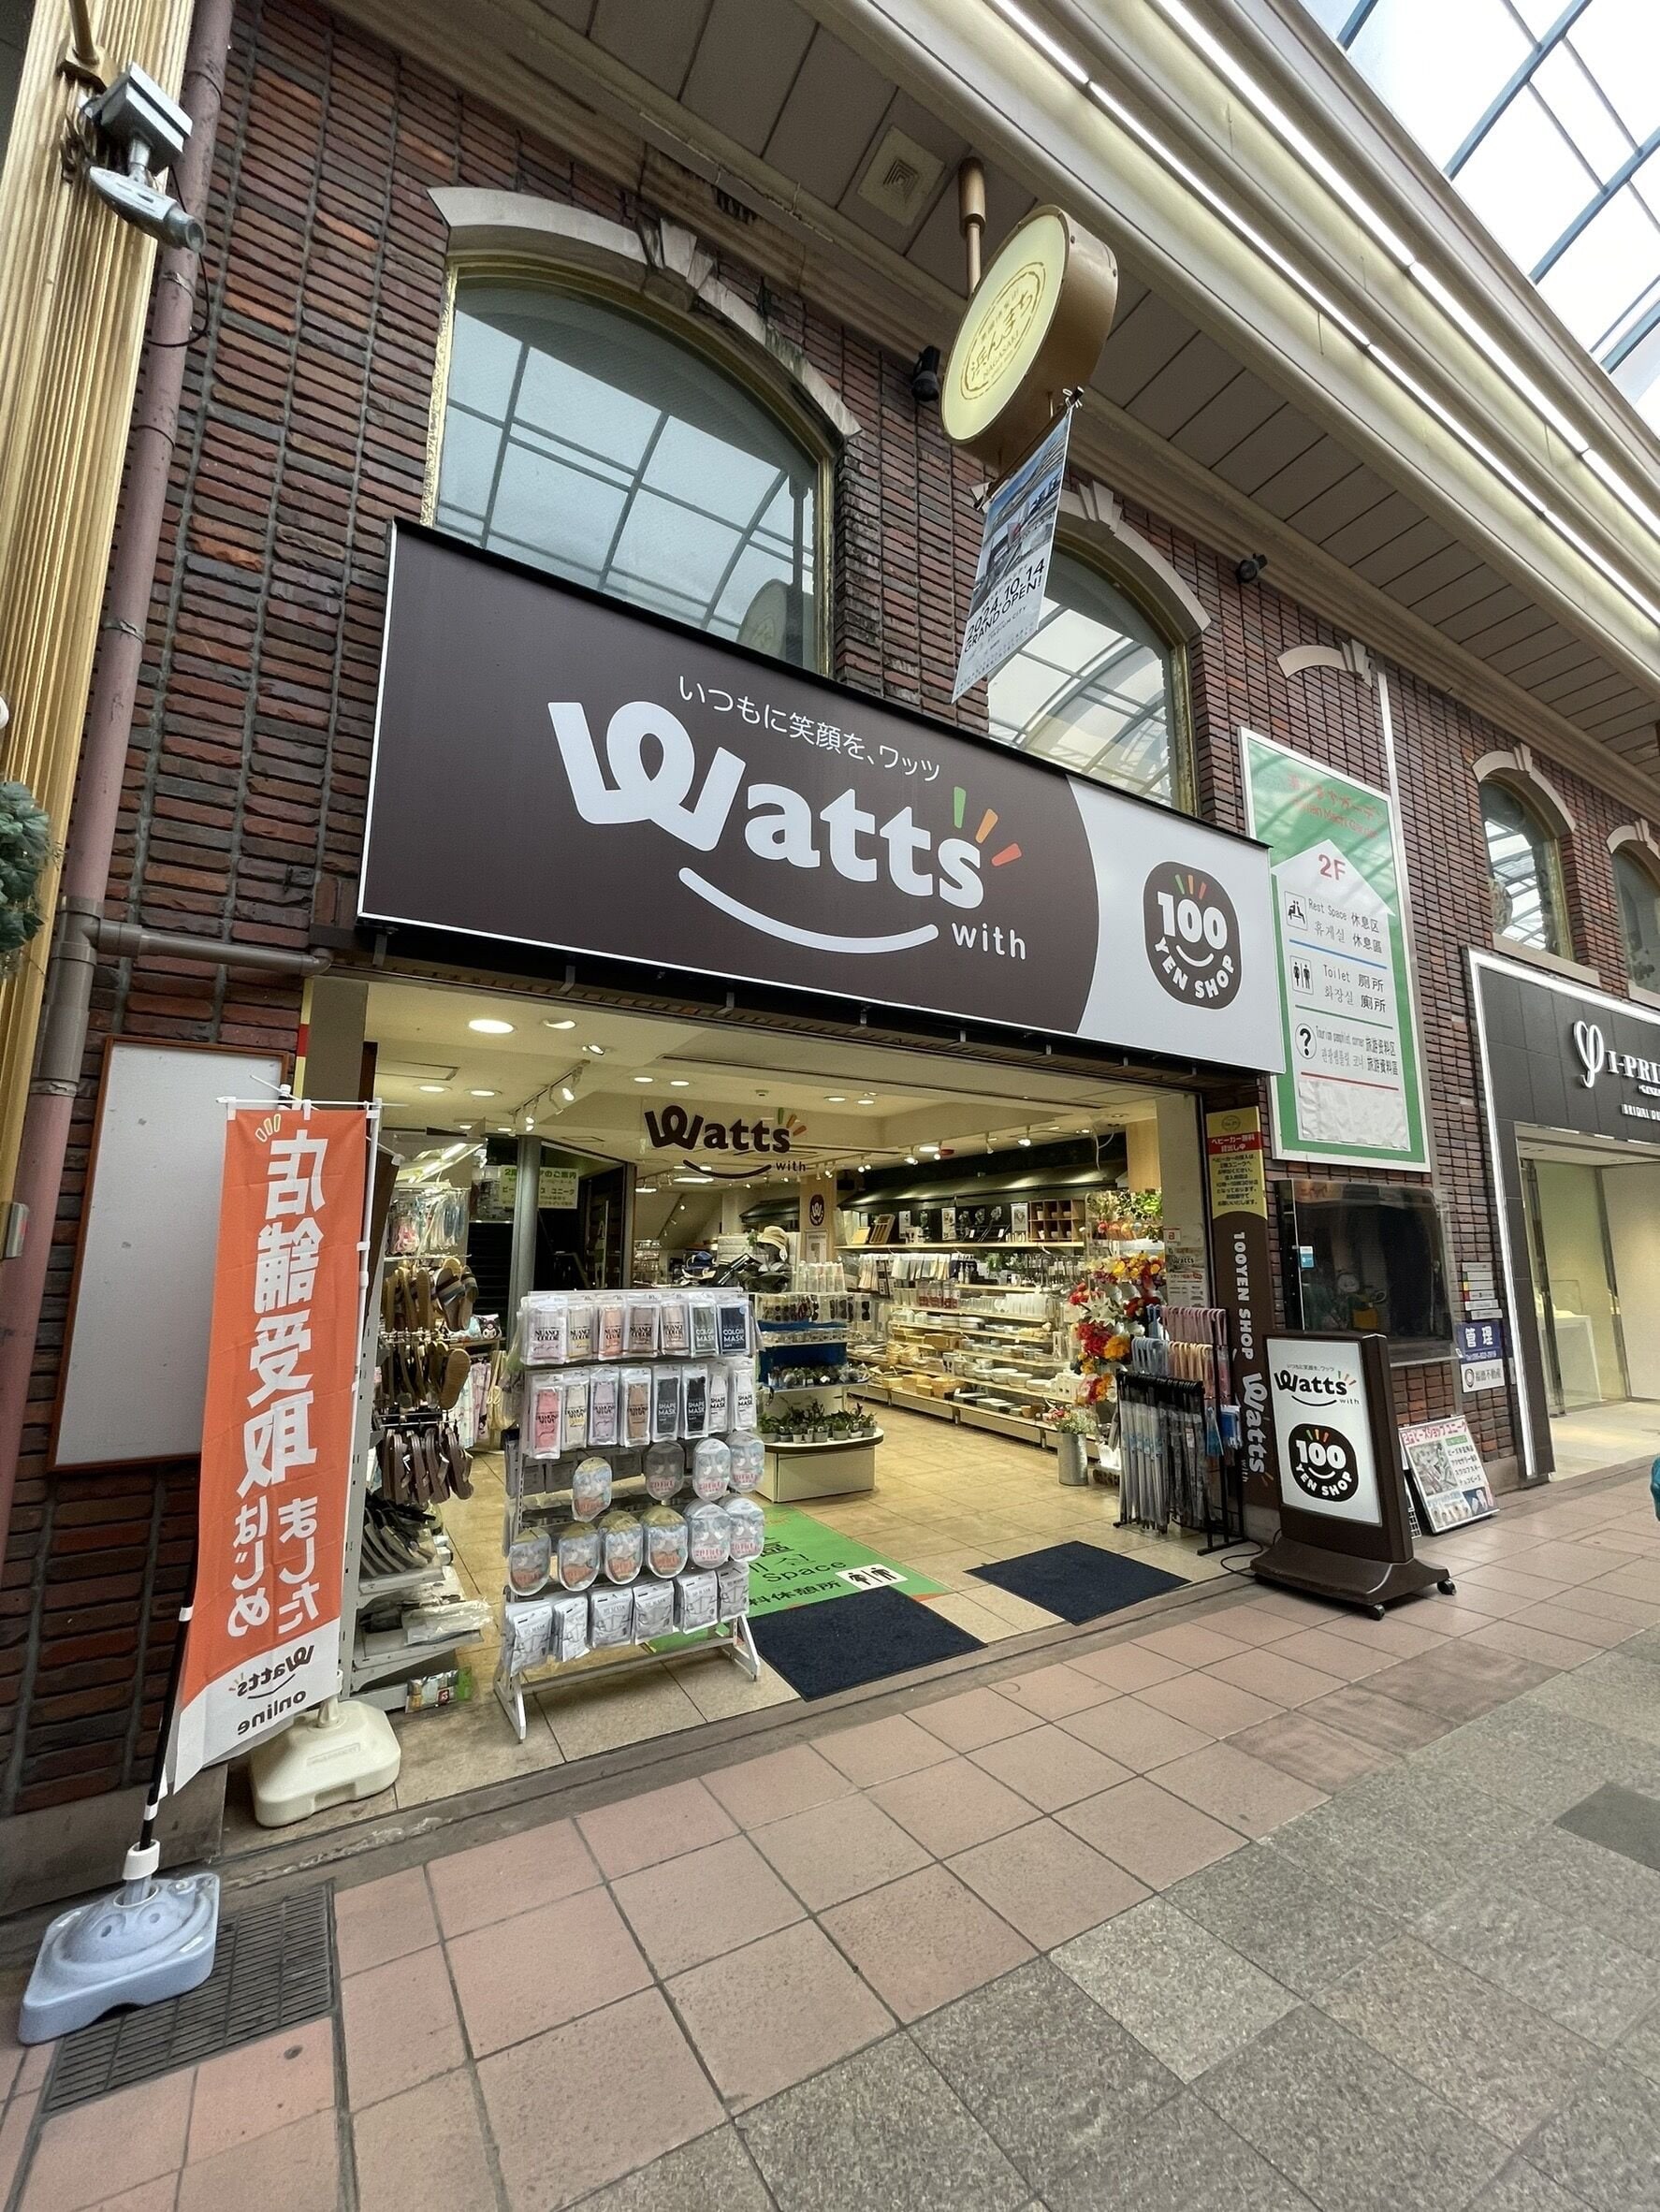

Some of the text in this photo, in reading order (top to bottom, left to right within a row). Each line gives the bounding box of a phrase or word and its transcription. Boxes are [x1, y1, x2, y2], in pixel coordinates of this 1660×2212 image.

[964, 611, 999, 653] GRAND
[1001, 575, 1041, 615] OPEN!
[680, 675, 940, 781] いつもに笑顔を、ワッツ
[547, 700, 984, 910] Watts
[1318, 853, 1346, 881] 2F
[1157, 890, 1228, 951] 100
[1308, 897, 1347, 921] Rest Space
[1350, 911, 1380, 934] 休息区
[951, 922, 1027, 961] with
[1314, 920, 1346, 944] 휴게실
[1154, 937, 1235, 999] YEN SHOP
[1323, 964, 1350, 983] Toilet
[1324, 985, 1354, 1006] 화장실
[1605, 1050, 1660, 1084] I-PRI
[644, 1105, 791, 1154] Watts
[776, 1161, 807, 1171] with
[1238, 1307, 1254, 1360] SHOP
[1274, 1369, 1347, 1396] Watts
[1242, 1373, 1268, 1474] Watts
[1295, 1439, 1347, 1470] 100
[1295, 1463, 1352, 1496] YEN SHOP
[762, 1561, 847, 1582] Space
